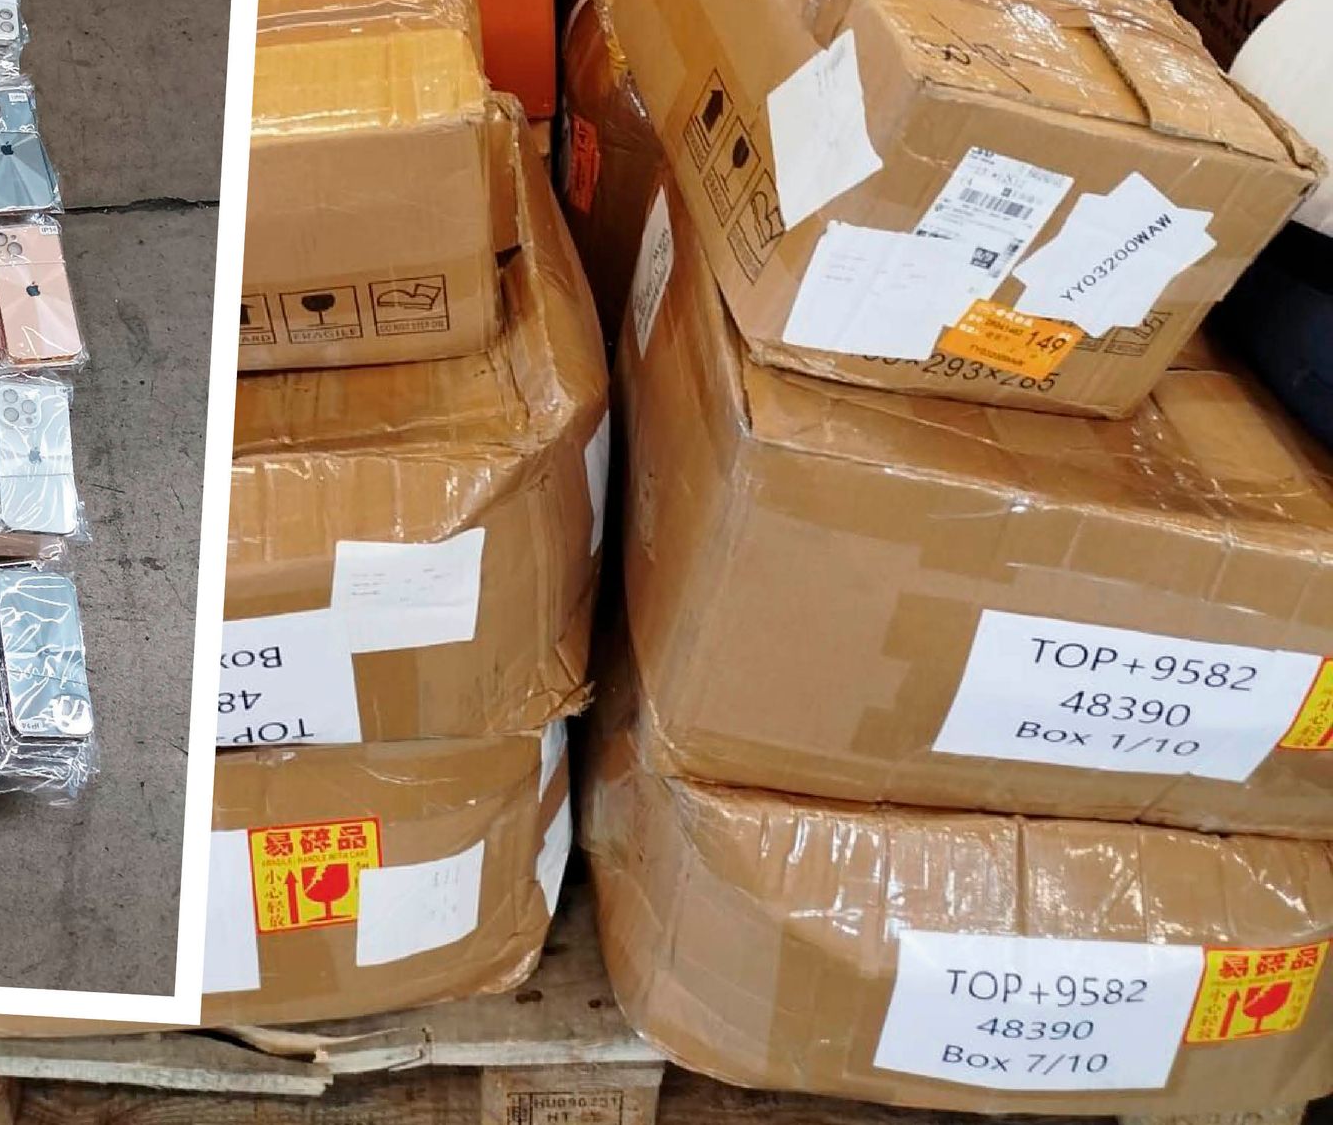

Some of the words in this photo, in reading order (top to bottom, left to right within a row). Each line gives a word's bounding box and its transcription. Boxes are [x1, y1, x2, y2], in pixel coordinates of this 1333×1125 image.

[292, 328, 359, 342] FRAGILE
[1025, 330, 1067, 355] 149
[1031, 637, 1258, 692] TOP+9582
[1058, 690, 1192, 728] 48390
[1015, 720, 1089, 748] Box
[1110, 732, 1200, 758] 1/10
[263, 824, 367, 857] 易碎品
[946, 969, 1149, 1007] TOP+9582
[975, 1017, 1094, 1041] 48390
[941, 1044, 1010, 1073] Box
[1026, 1052, 1108, 1076] 7/10
